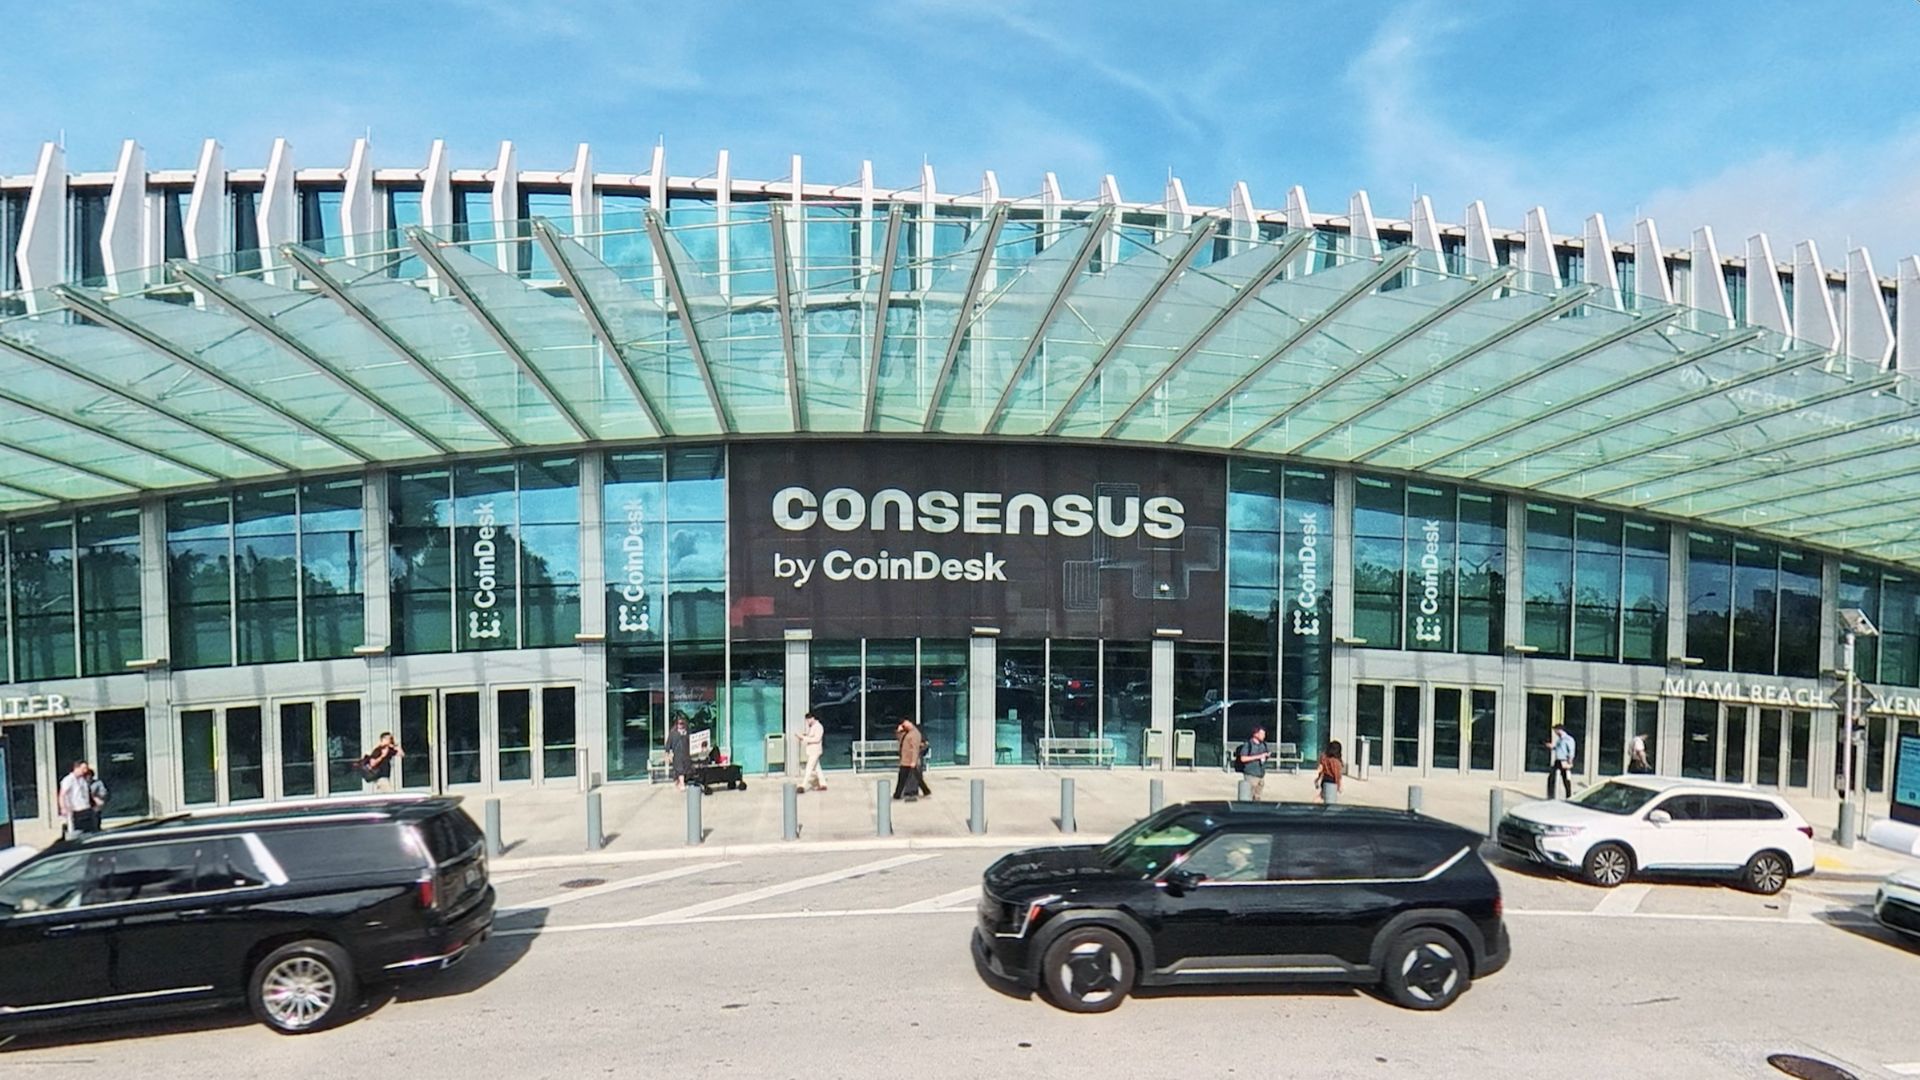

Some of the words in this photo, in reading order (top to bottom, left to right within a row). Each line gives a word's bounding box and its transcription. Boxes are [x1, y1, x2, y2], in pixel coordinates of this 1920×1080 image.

[622, 498, 645, 603] CoinDesk
[772, 486, 1186, 540] CONSENSUS
[473, 501, 497, 609] CoinDesk
[773, 553, 817, 588] by
[822, 549, 1008, 582] CoinDesk
[1298, 511, 1318, 608] CoinDesk
[1420, 519, 1440, 615] CoinDesk
[0, 694, 67, 719] TER
[1665, 677, 1747, 702] MIAMI
[1750, 683, 1825, 708] BEACH
